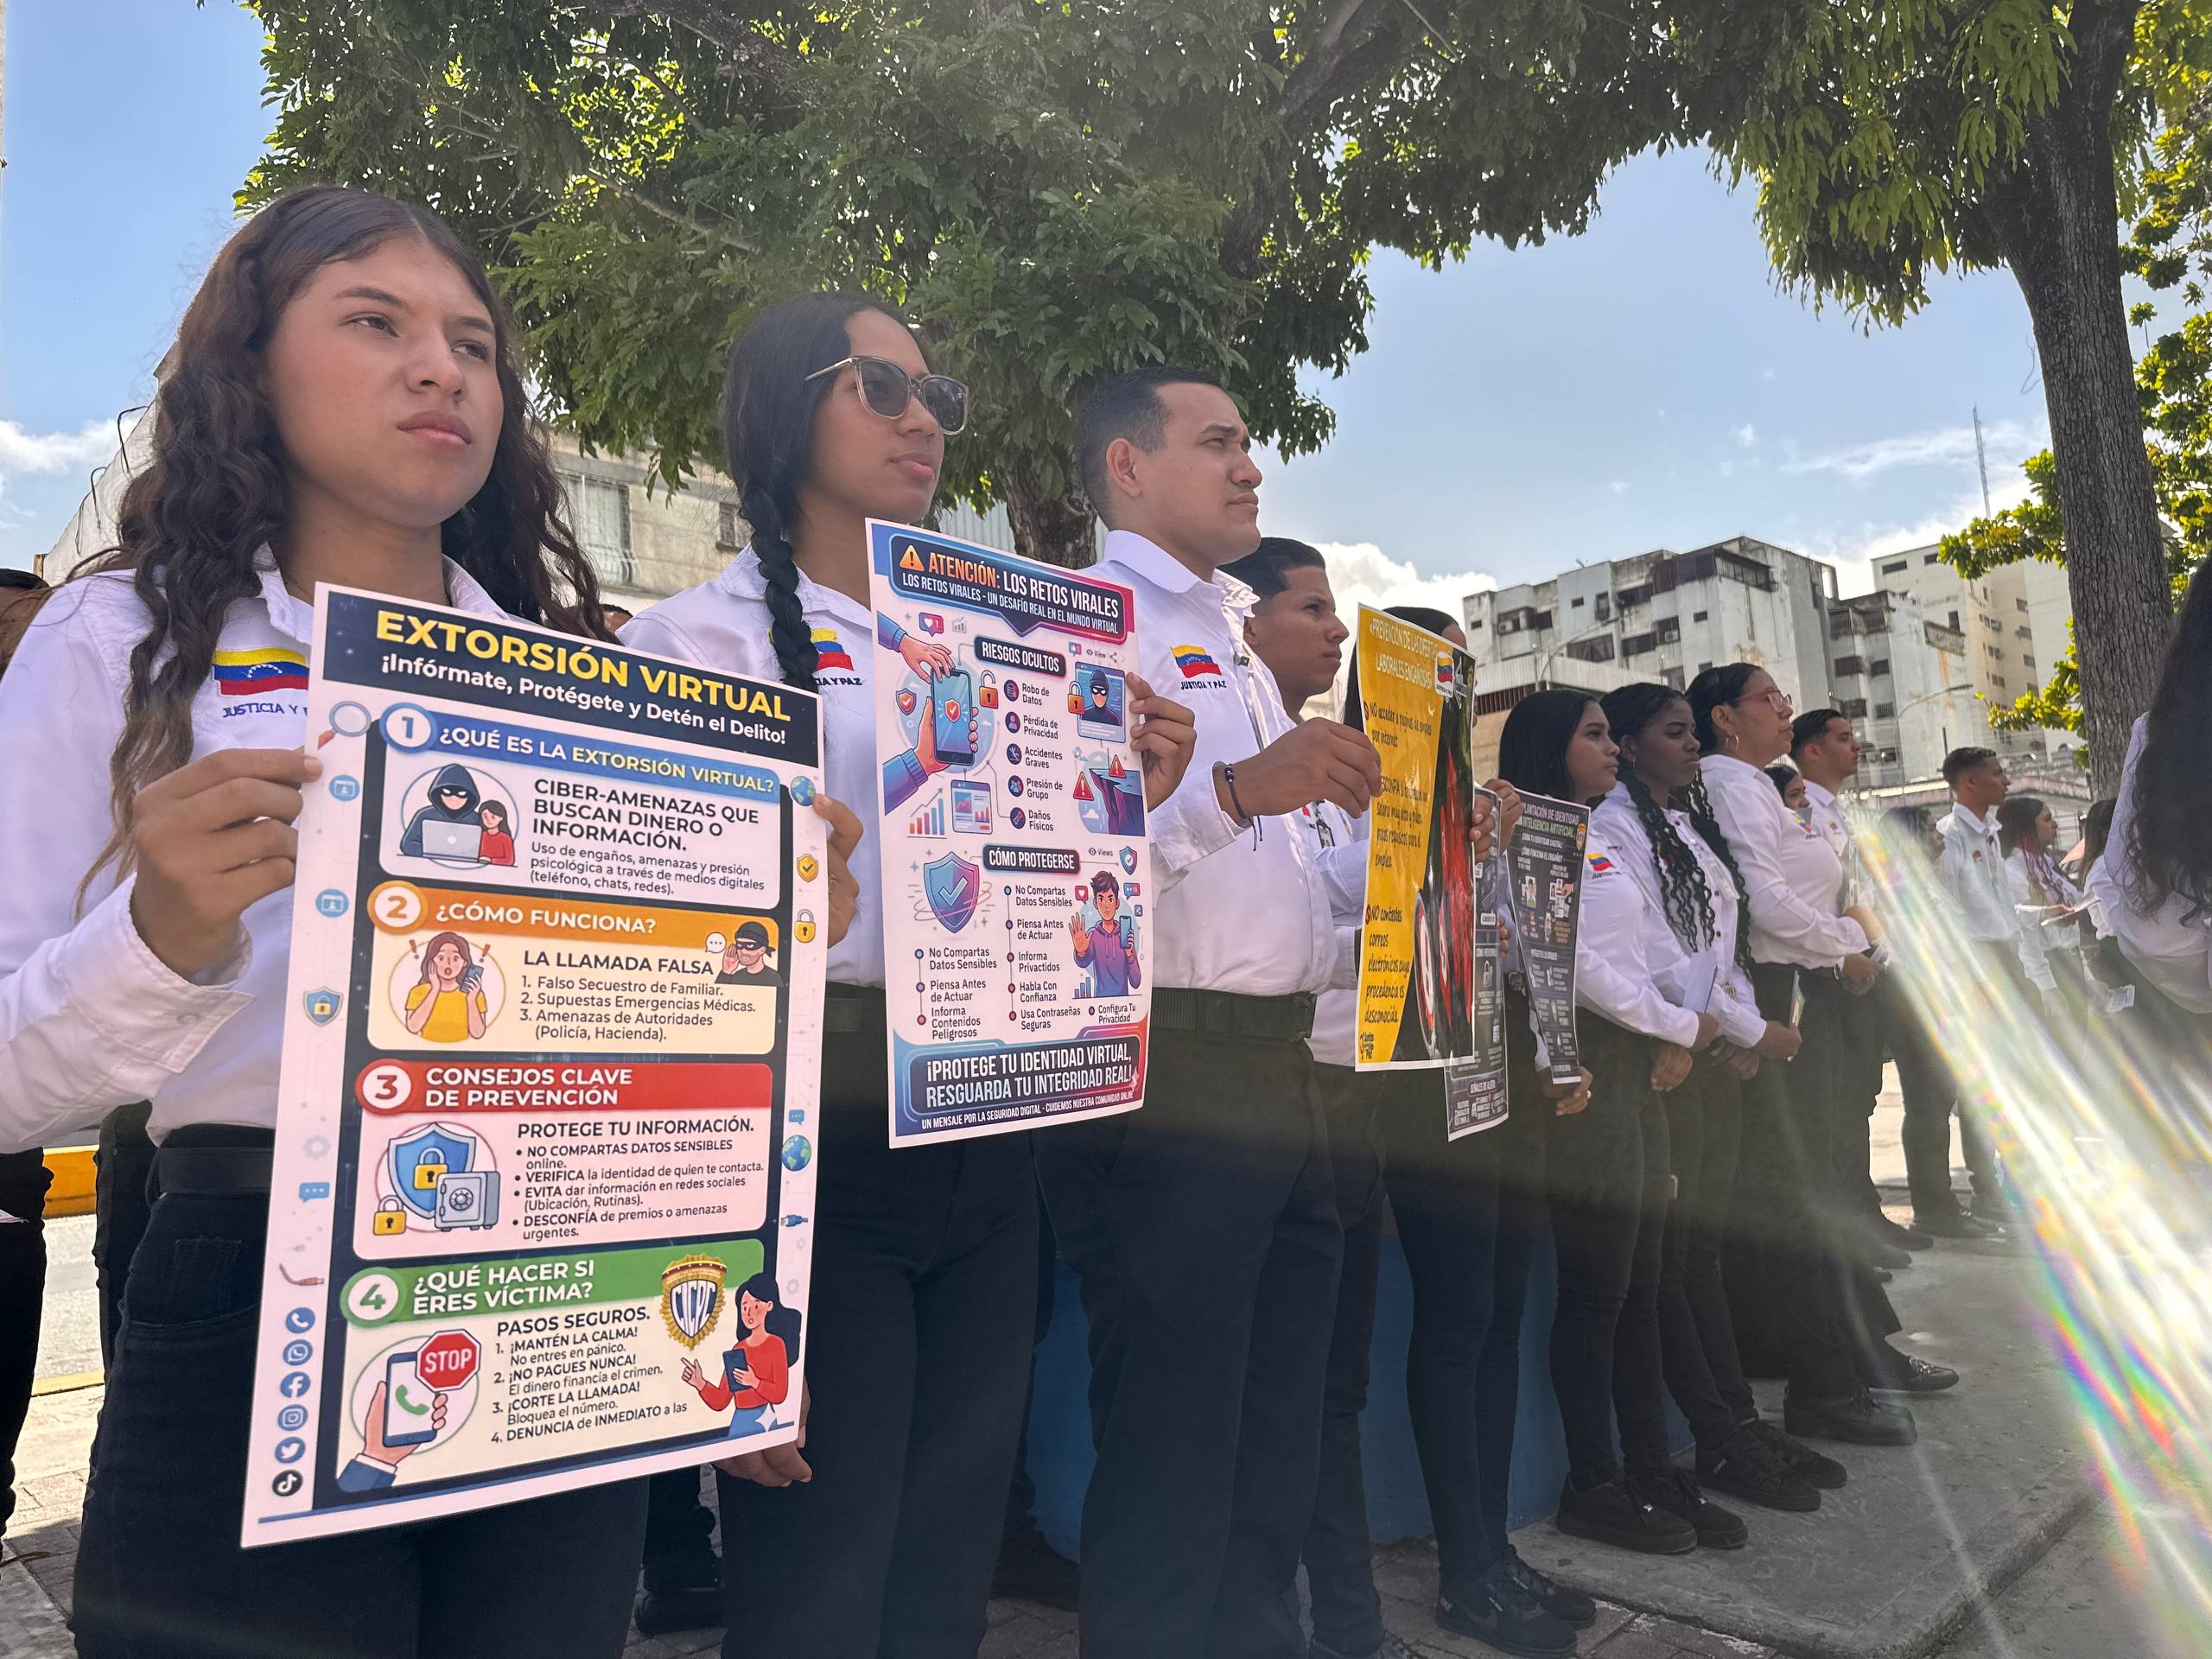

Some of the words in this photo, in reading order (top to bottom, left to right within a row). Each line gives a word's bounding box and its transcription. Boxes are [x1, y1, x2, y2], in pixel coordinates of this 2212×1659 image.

[929, 551, 1001, 589] ATENCIÓN:
[1003, 570, 1027, 596] LOS
[1030, 578, 1068, 607] RETOS
[1071, 588, 1119, 619] VIRALES
[902, 572, 919, 588] LOS
[921, 575, 948, 594] RETOS
[949, 582, 981, 601] VIRALES
[987, 591, 998, 605] UN
[999, 594, 1028, 613] DESAFÍO
[1029, 601, 1046, 618] REAL
[1046, 607, 1056, 620] EN
[1057, 609, 1066, 622] EL
[1066, 611, 1090, 628] MUNDO
[1090, 617, 1118, 634] VIRTUAL
[376, 609, 629, 688] EXTORSIÓN
[639, 664, 791, 722] VIRTUAL
[982, 641, 1020, 664] RIESGOS
[1021, 650, 1059, 672] OCULTOS
[1181, 681, 1207, 690] JUSTICIA
[222, 702, 285, 718] JUSTICIA
[289, 704, 299, 715] Y
[382, 653, 512, 695] ¡Infórmate,
[519, 677, 624, 712] Protégete
[628, 702, 641, 719] y
[646, 702, 703, 728] Detén
[709, 716, 725, 732] el
[730, 719, 785, 744] Delito!
[402, 715, 414, 739] 1
[1023, 715, 1048, 728] Pérdida
[1049, 719, 1058, 729] de
[1023, 725, 1058, 740] Privacidad
[440, 727, 500, 749] ¿QUÉ
[507, 735, 533, 753] ES
[539, 741, 567, 760] LA
[572, 747, 685, 779] EXTORSIÓN
[690, 766, 773, 792] VIRTUAL?
[1025, 746, 1063, 760] Accidentes
[1025, 756, 1050, 769] Graves
[1026, 778, 1052, 789] Presión
[1053, 780, 1063, 791] de
[1027, 788, 1048, 801] Grupo
[534, 779, 715, 817] CIBER-AMENAZAS
[721, 805, 759, 823] QUE
[1028, 809, 1051, 820] Daños
[533, 817, 686, 851] INFORMACIÓN.
[531, 841, 555, 855] Uso
[559, 845, 576, 856] de
[579, 849, 635, 865] engaños,
[639, 855, 697, 870] amenazas
[700, 862, 707, 874] y
[709, 863, 749, 875] presión
[988, 847, 1016, 867] CÓMO
[1018, 851, 1075, 869] PROTEGERSE
[530, 869, 591, 888] (teléfono,
[594, 876, 631, 892] chats,
[634, 881, 674, 895] redes).
[386, 895, 407, 918] 2
[435, 901, 524, 924] ¿CÓMO
[531, 909, 656, 933] FUNCIONA?
[1369, 934, 1389, 947] correos
[524, 950, 549, 966] LA
[556, 951, 652, 971] LLAMADA
[658, 958, 714, 975] FALSA
[1018, 950, 1047, 961] Informa
[1097, 1003, 1128, 1014] Configura
[1128, 1002, 1135, 1012] Tu
[1098, 1013, 1130, 1024] Privacidad
[927, 1054, 997, 1082] ¡PROTEGE
[1000, 1053, 1017, 1073] TU
[1020, 1047, 1084, 1071] IDENTIDAD
[1087, 1042, 1132, 1065] VIRTUAL,
[374, 1074, 397, 1100] 3
[426, 1067, 555, 1085] CONSEJOS
[561, 1069, 632, 1085] CLAVE
[926, 1082, 1011, 1109] RESGUARDA
[1013, 1077, 1031, 1097] TU
[1035, 1069, 1103, 1095] INTEGRIDAD
[1105, 1064, 1132, 1084] REAL!
[425, 1090, 460, 1106] DE
[467, 1089, 618, 1106] PREVENCIÓN
[922, 1118, 933, 1129] UN
[935, 1114, 963, 1128] MENSAJE
[963, 1113, 977, 1124] POR
[977, 1112, 987, 1122] LA
[987, 1107, 1020, 1121] SEGURIDAD
[1020, 1103, 1041, 1116] DIGITAL
[1046, 1099, 1072, 1113] CUIDEMOS
[1073, 1096, 1095, 1109] NUESTRA
[518, 1122, 603, 1138] PROTEGE
[607, 1121, 631, 1135] TU
[636, 1118, 753, 1135] INFORMACIÓN.
[525, 1157, 567, 1170] online.
[525, 1169, 584, 1183] VERIFICA
[588, 1168, 598, 1180] la
[601, 1166, 655, 1179] identidad
[658, 1165, 671, 1176] de
[673, 1163, 703, 1178] quien
[706, 1164, 716, 1174] te
[718, 1161, 764, 1173] contacta.
[414, 1265, 480, 1294] ¿QUÉ
[488, 1262, 568, 1285] HACER
[574, 1260, 594, 1277] SI
[359, 1283, 386, 1310] 4
[413, 1292, 477, 1314] ERES
[484, 1281, 593, 1307] VÍCTIMA?
[424, 1348, 472, 1373] STOP
[510, 1354, 527, 1366] No
[530, 1351, 567, 1363] entres
[569, 1348, 584, 1358] en
[587, 1342, 626, 1358] pánico.
